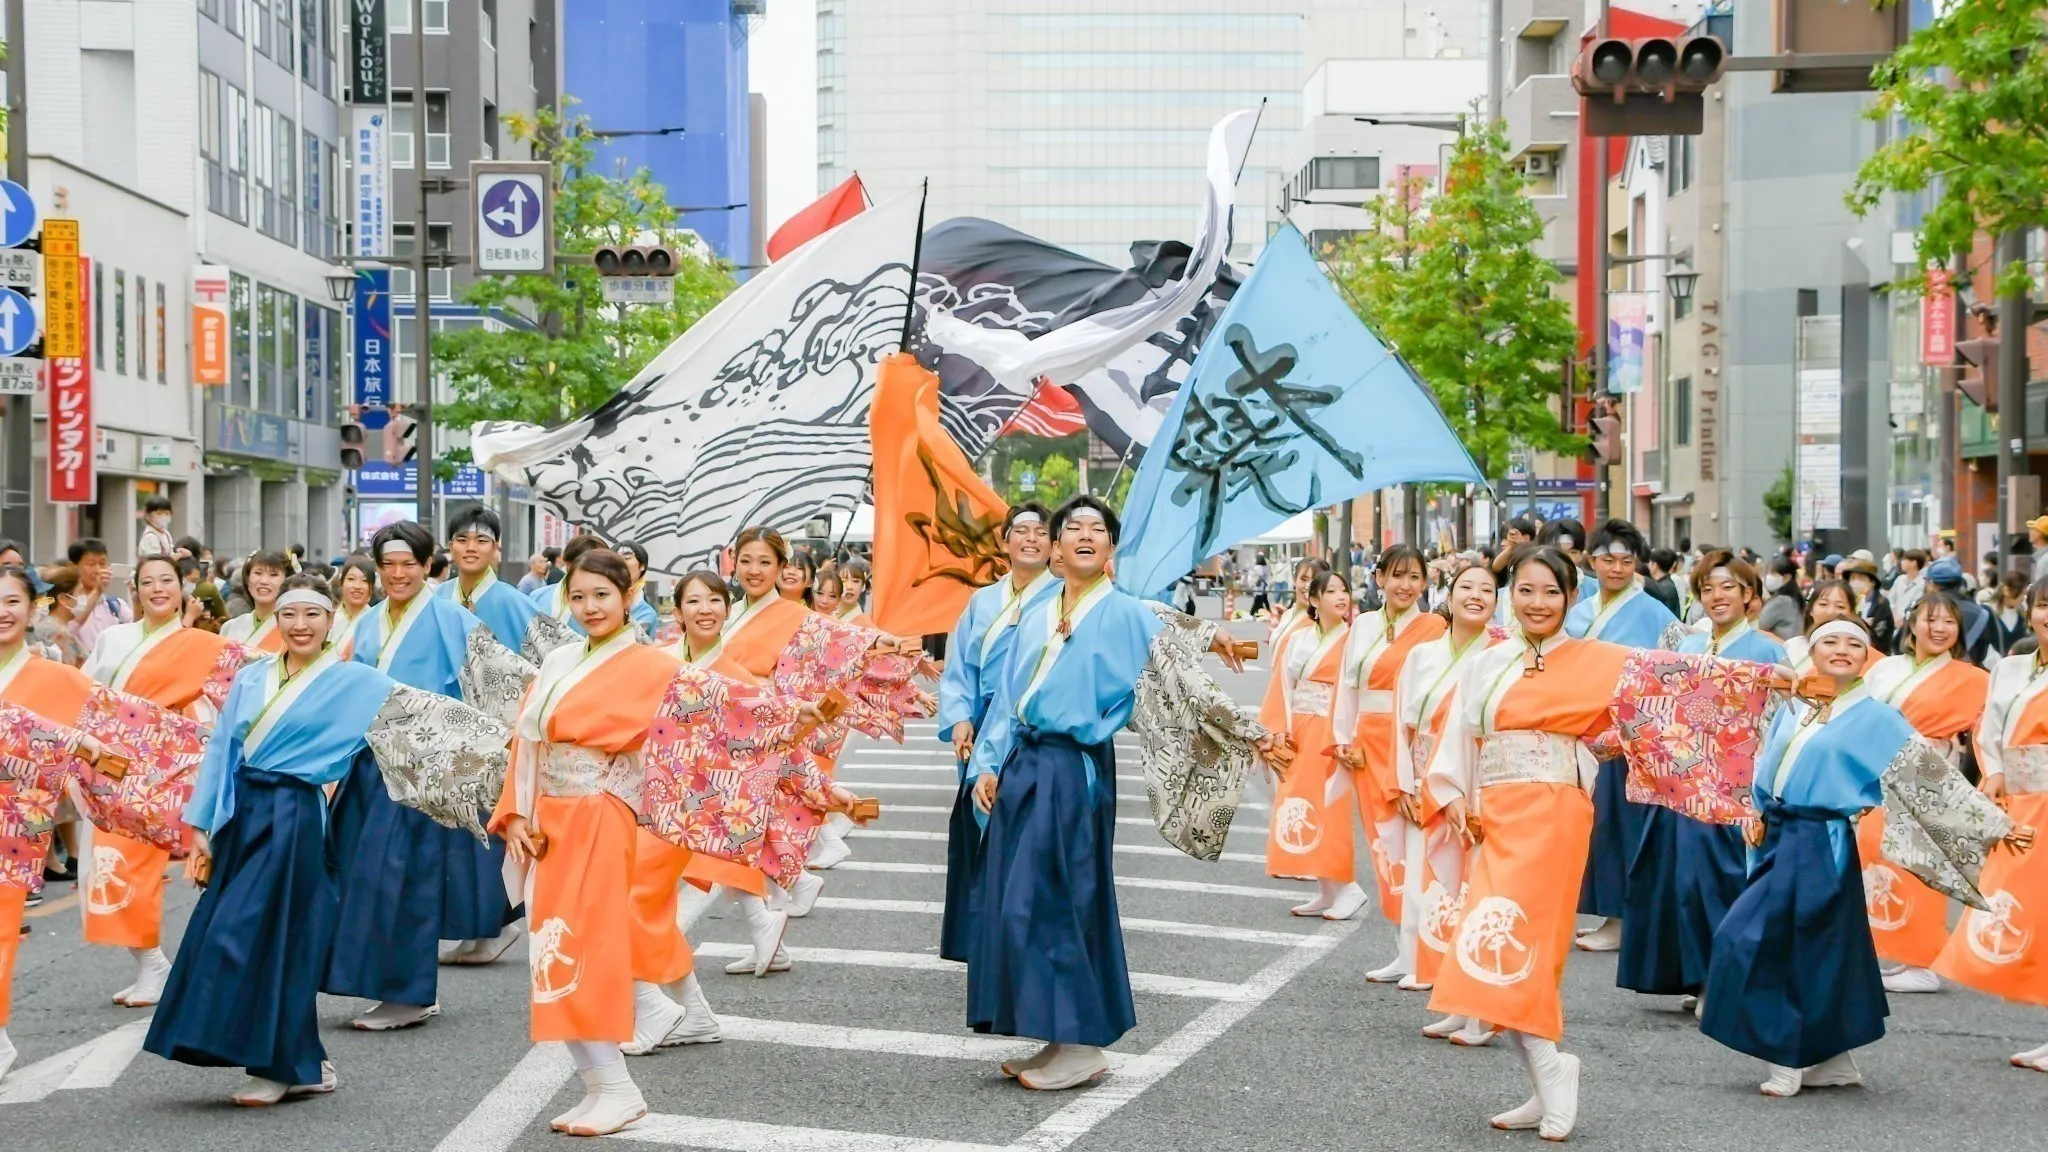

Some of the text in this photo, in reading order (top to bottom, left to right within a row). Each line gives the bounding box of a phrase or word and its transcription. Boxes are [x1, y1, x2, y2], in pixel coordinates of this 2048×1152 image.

[355, 0, 374, 97] Workout
[373, 37, 384, 96] ワークアウト
[0, 254, 33, 268] を除く
[485, 247, 539, 262] 自転車を除く
[1701, 300, 1719, 357] TAG
[0, 363, 33, 375] を除く
[363, 339, 382, 407] 日本旅行
[1701, 389, 1718, 482] Printing
[361, 471, 400, 481] 株式会社
